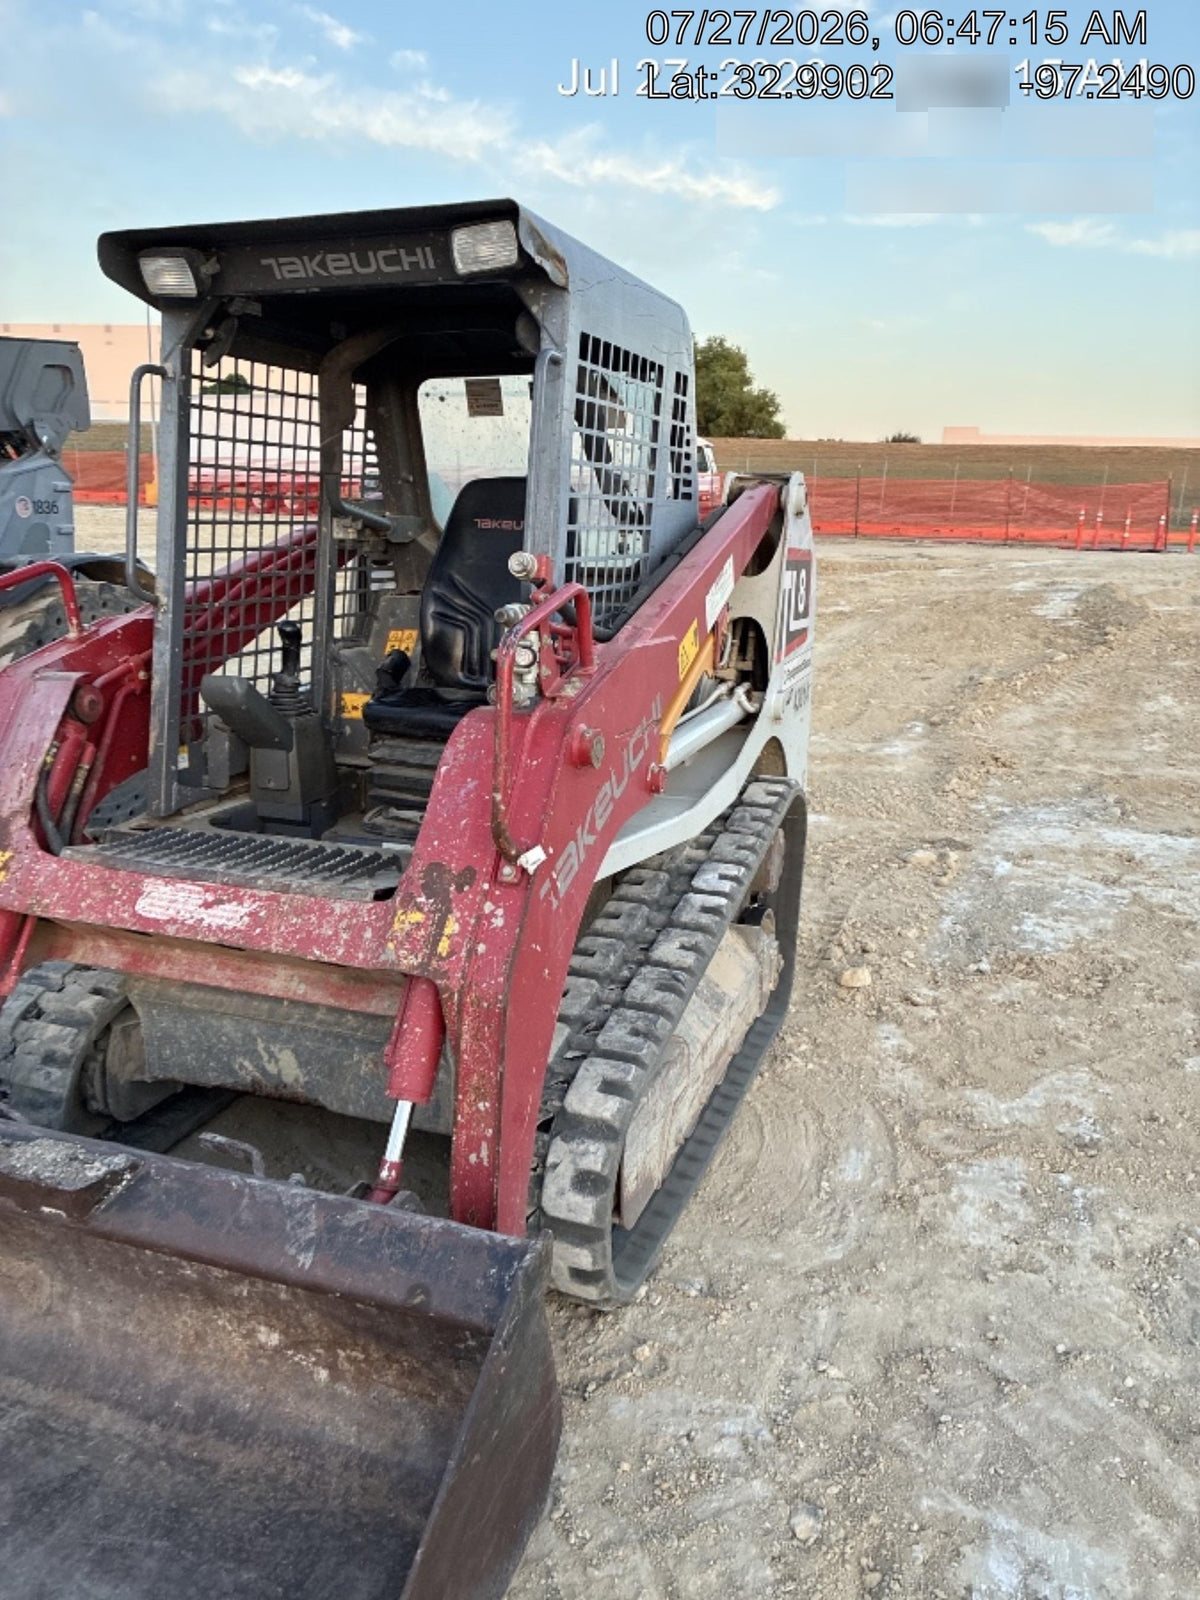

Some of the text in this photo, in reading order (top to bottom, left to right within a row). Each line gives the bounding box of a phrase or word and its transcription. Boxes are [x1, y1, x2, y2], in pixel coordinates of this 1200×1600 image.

[260, 246, 436, 280] TAKEUCHI
[473, 518, 524, 531] TAKEU
[539, 692, 664, 909] TAKEUCHI
